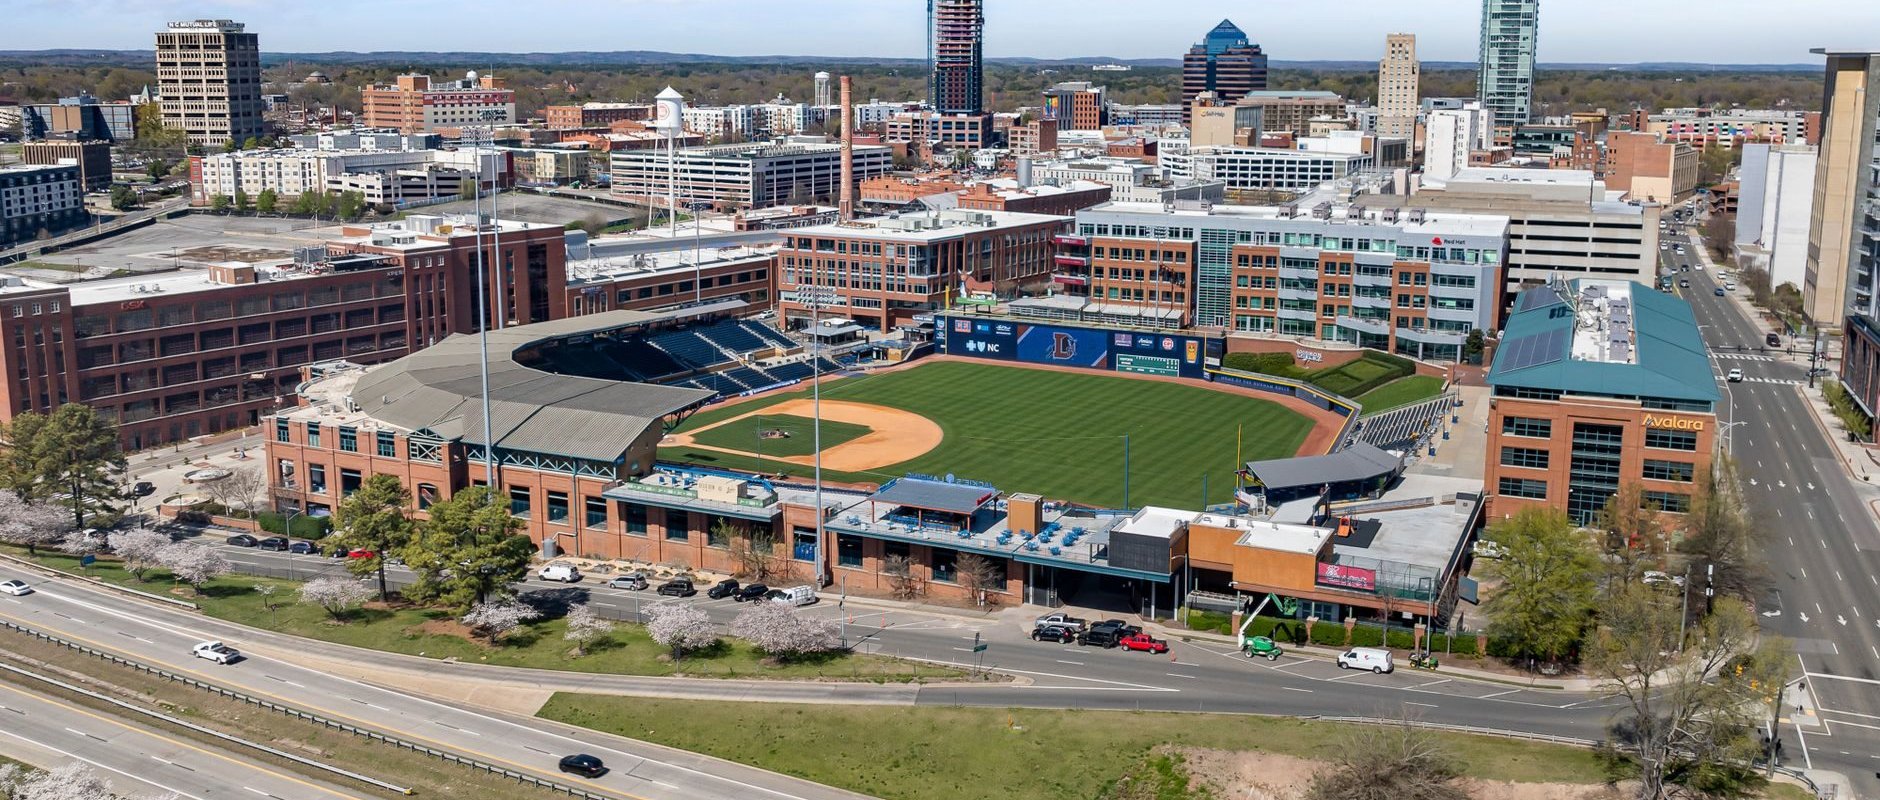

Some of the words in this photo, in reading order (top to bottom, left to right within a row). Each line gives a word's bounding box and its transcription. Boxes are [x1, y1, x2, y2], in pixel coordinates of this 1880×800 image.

[120, 300, 146, 310] GSK
[987, 343, 1000, 352] NC
[1641, 413, 1704, 431] Avalara
